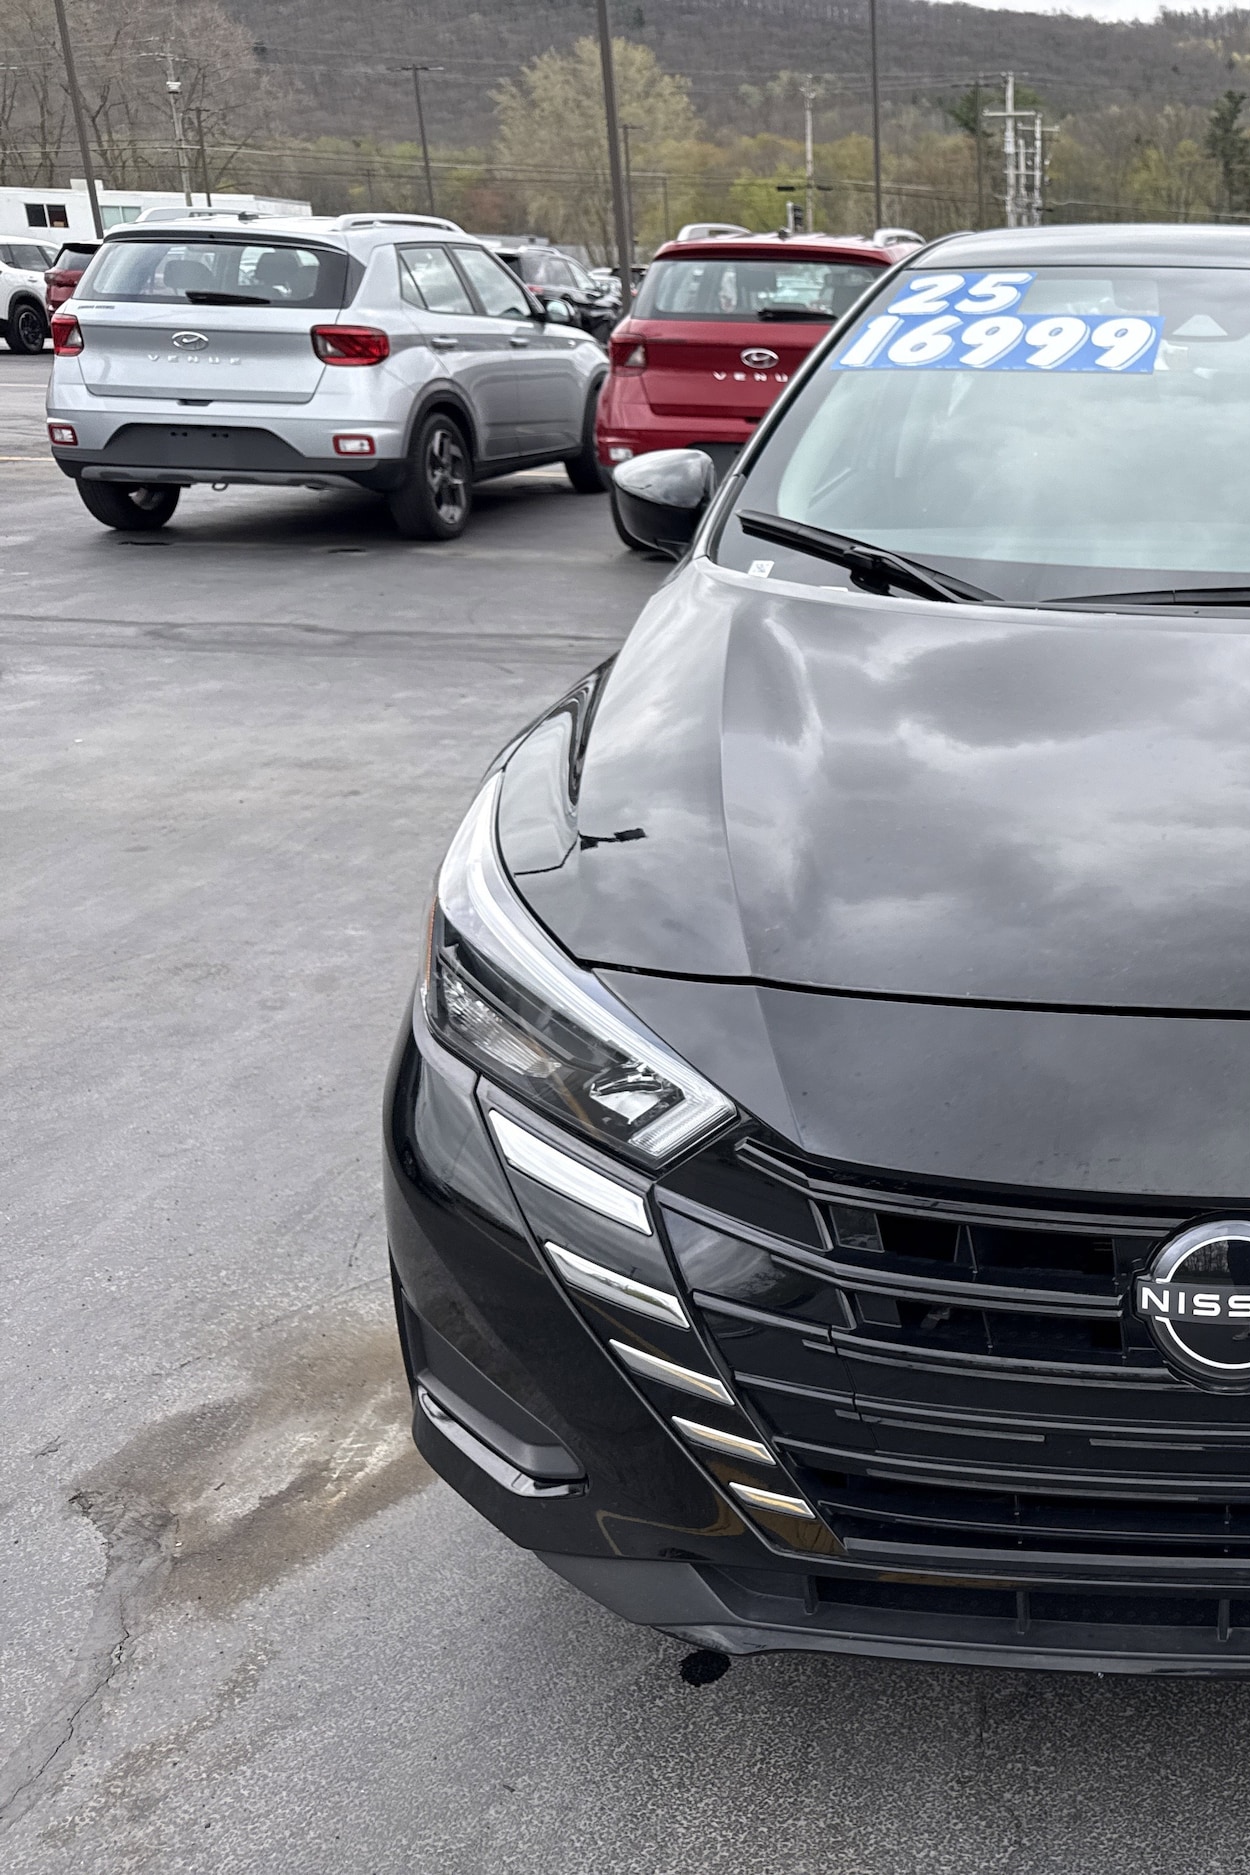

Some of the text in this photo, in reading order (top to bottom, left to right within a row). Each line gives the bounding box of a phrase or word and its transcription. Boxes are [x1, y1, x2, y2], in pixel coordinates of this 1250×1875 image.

[887, 272, 1033, 315] 25
[839, 314, 1157, 371] 16999
[147, 354, 242, 365] VENUE
[712, 371, 789, 383] VENU
